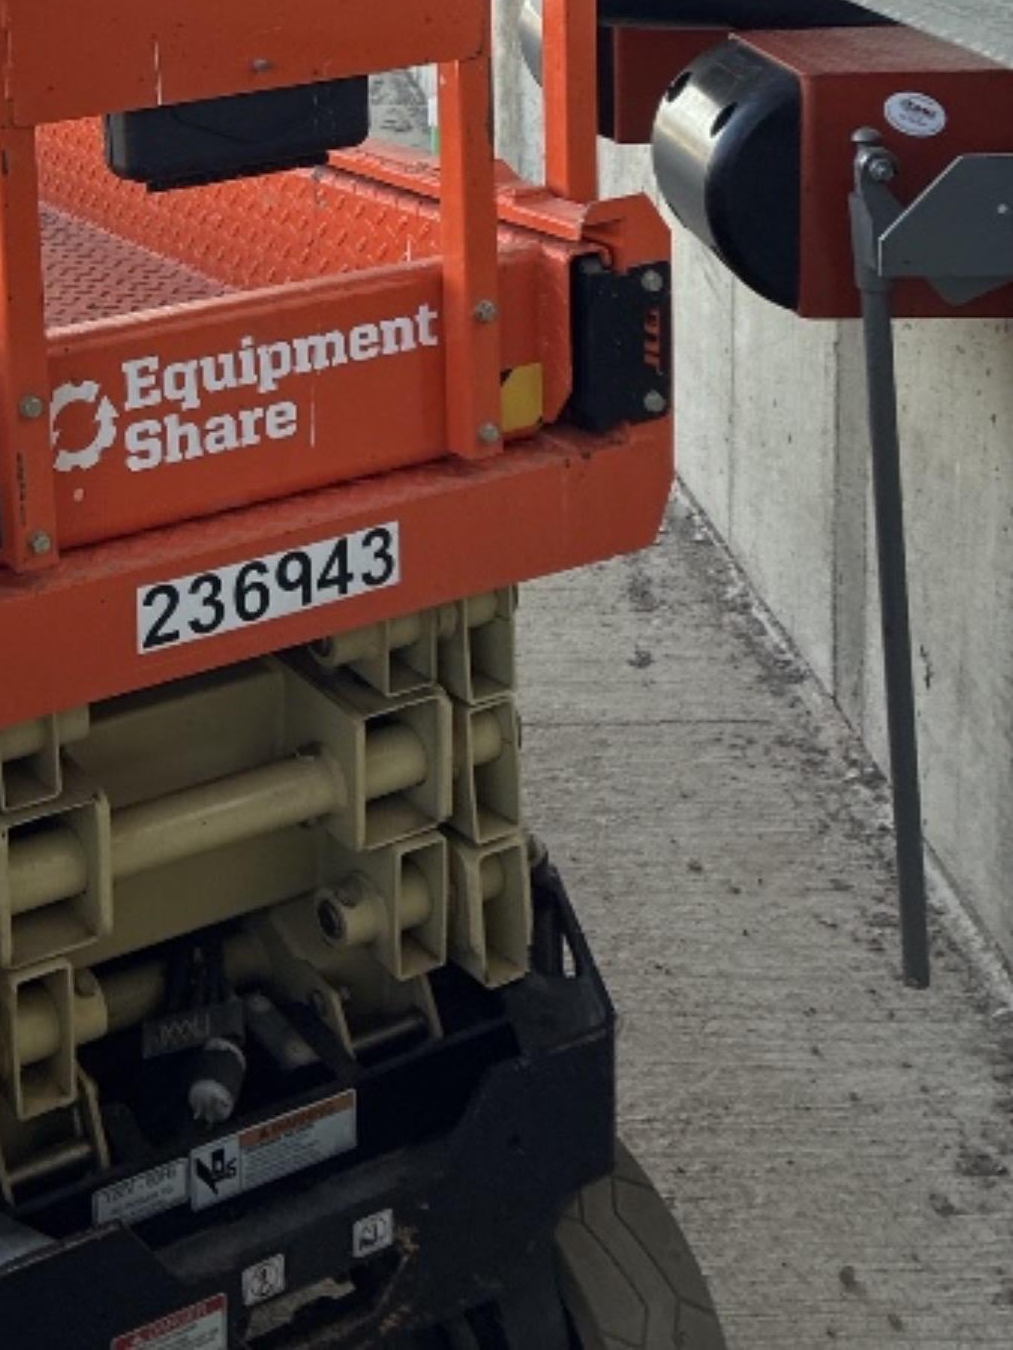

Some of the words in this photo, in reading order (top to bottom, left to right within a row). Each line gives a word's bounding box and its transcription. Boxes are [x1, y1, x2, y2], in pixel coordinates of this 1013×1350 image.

[121, 302, 439, 412] Equipment
[124, 400, 297, 473] Share
[141, 527, 395, 650] 236943
